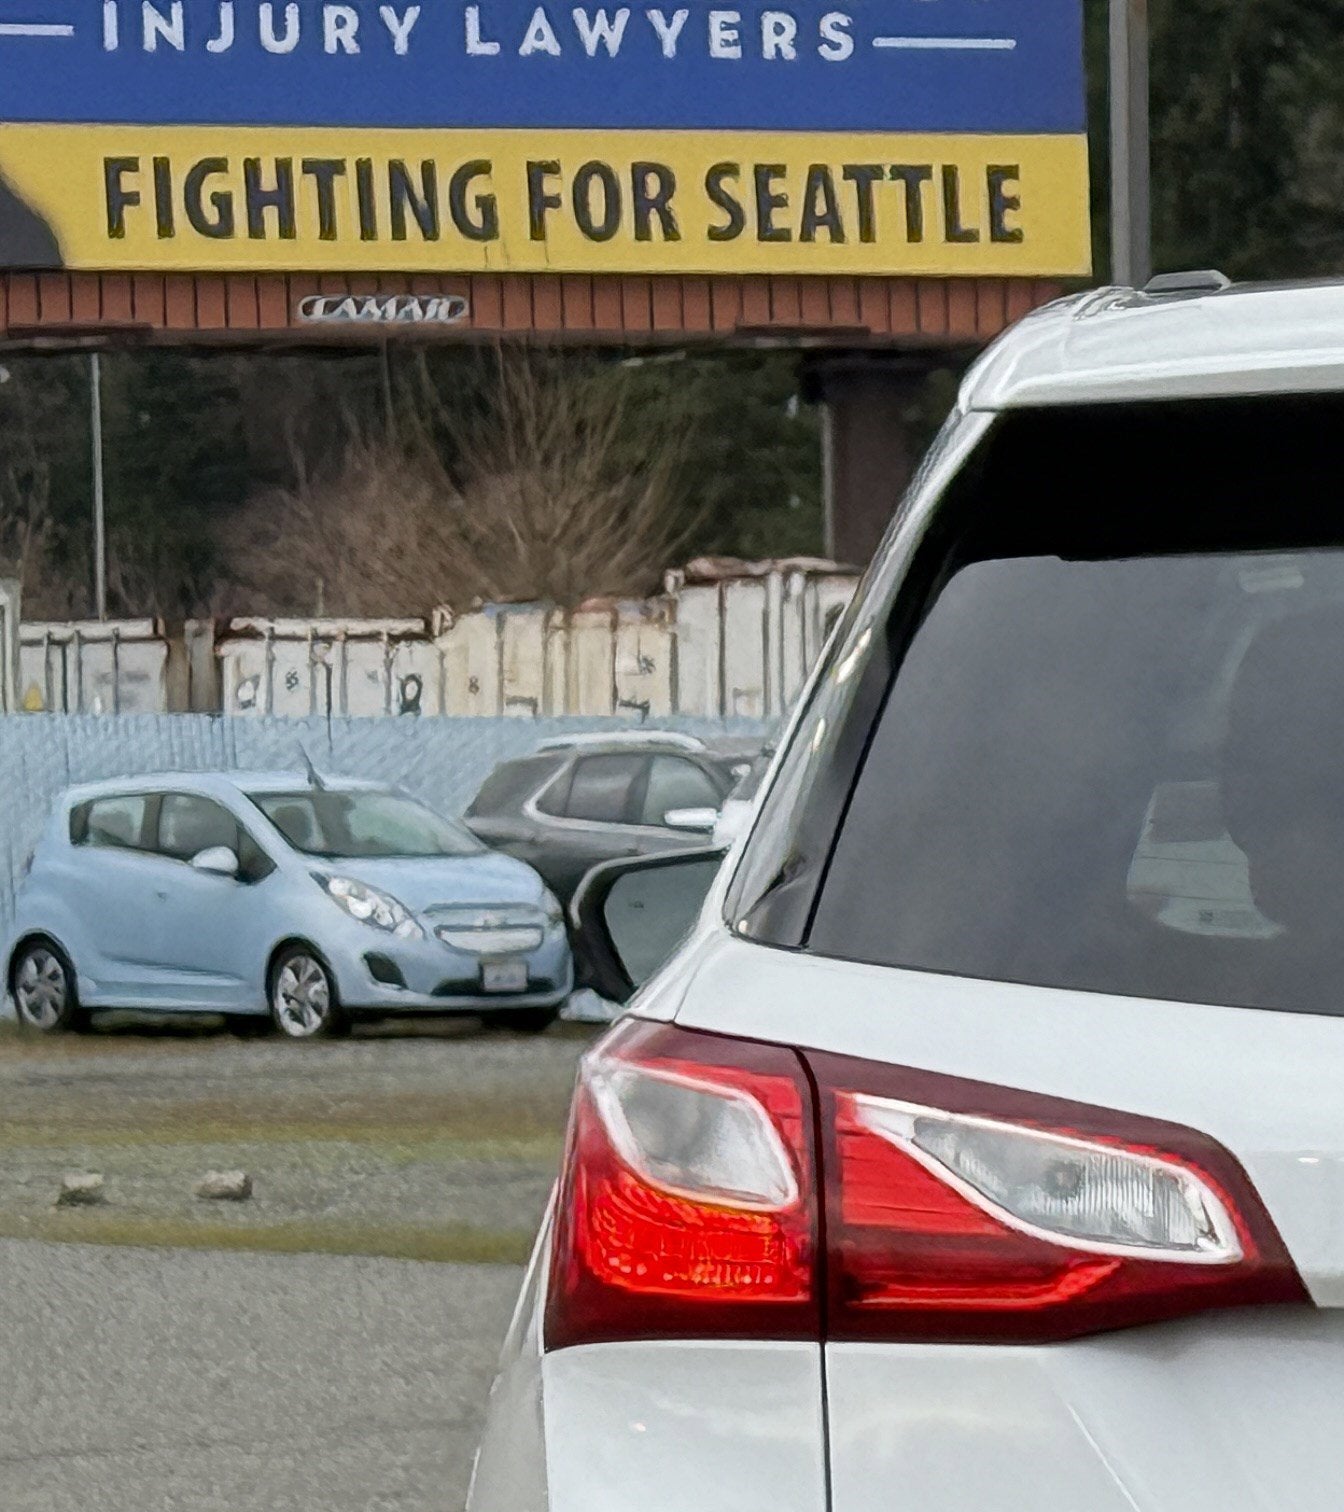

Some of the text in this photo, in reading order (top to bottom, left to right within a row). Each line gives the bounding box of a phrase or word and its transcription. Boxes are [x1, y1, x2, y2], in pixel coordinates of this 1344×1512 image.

[102, 0, 855, 62] INJURY LAWYERS
[103, 155, 1024, 244] FIGHTING FOR SEATTLE
